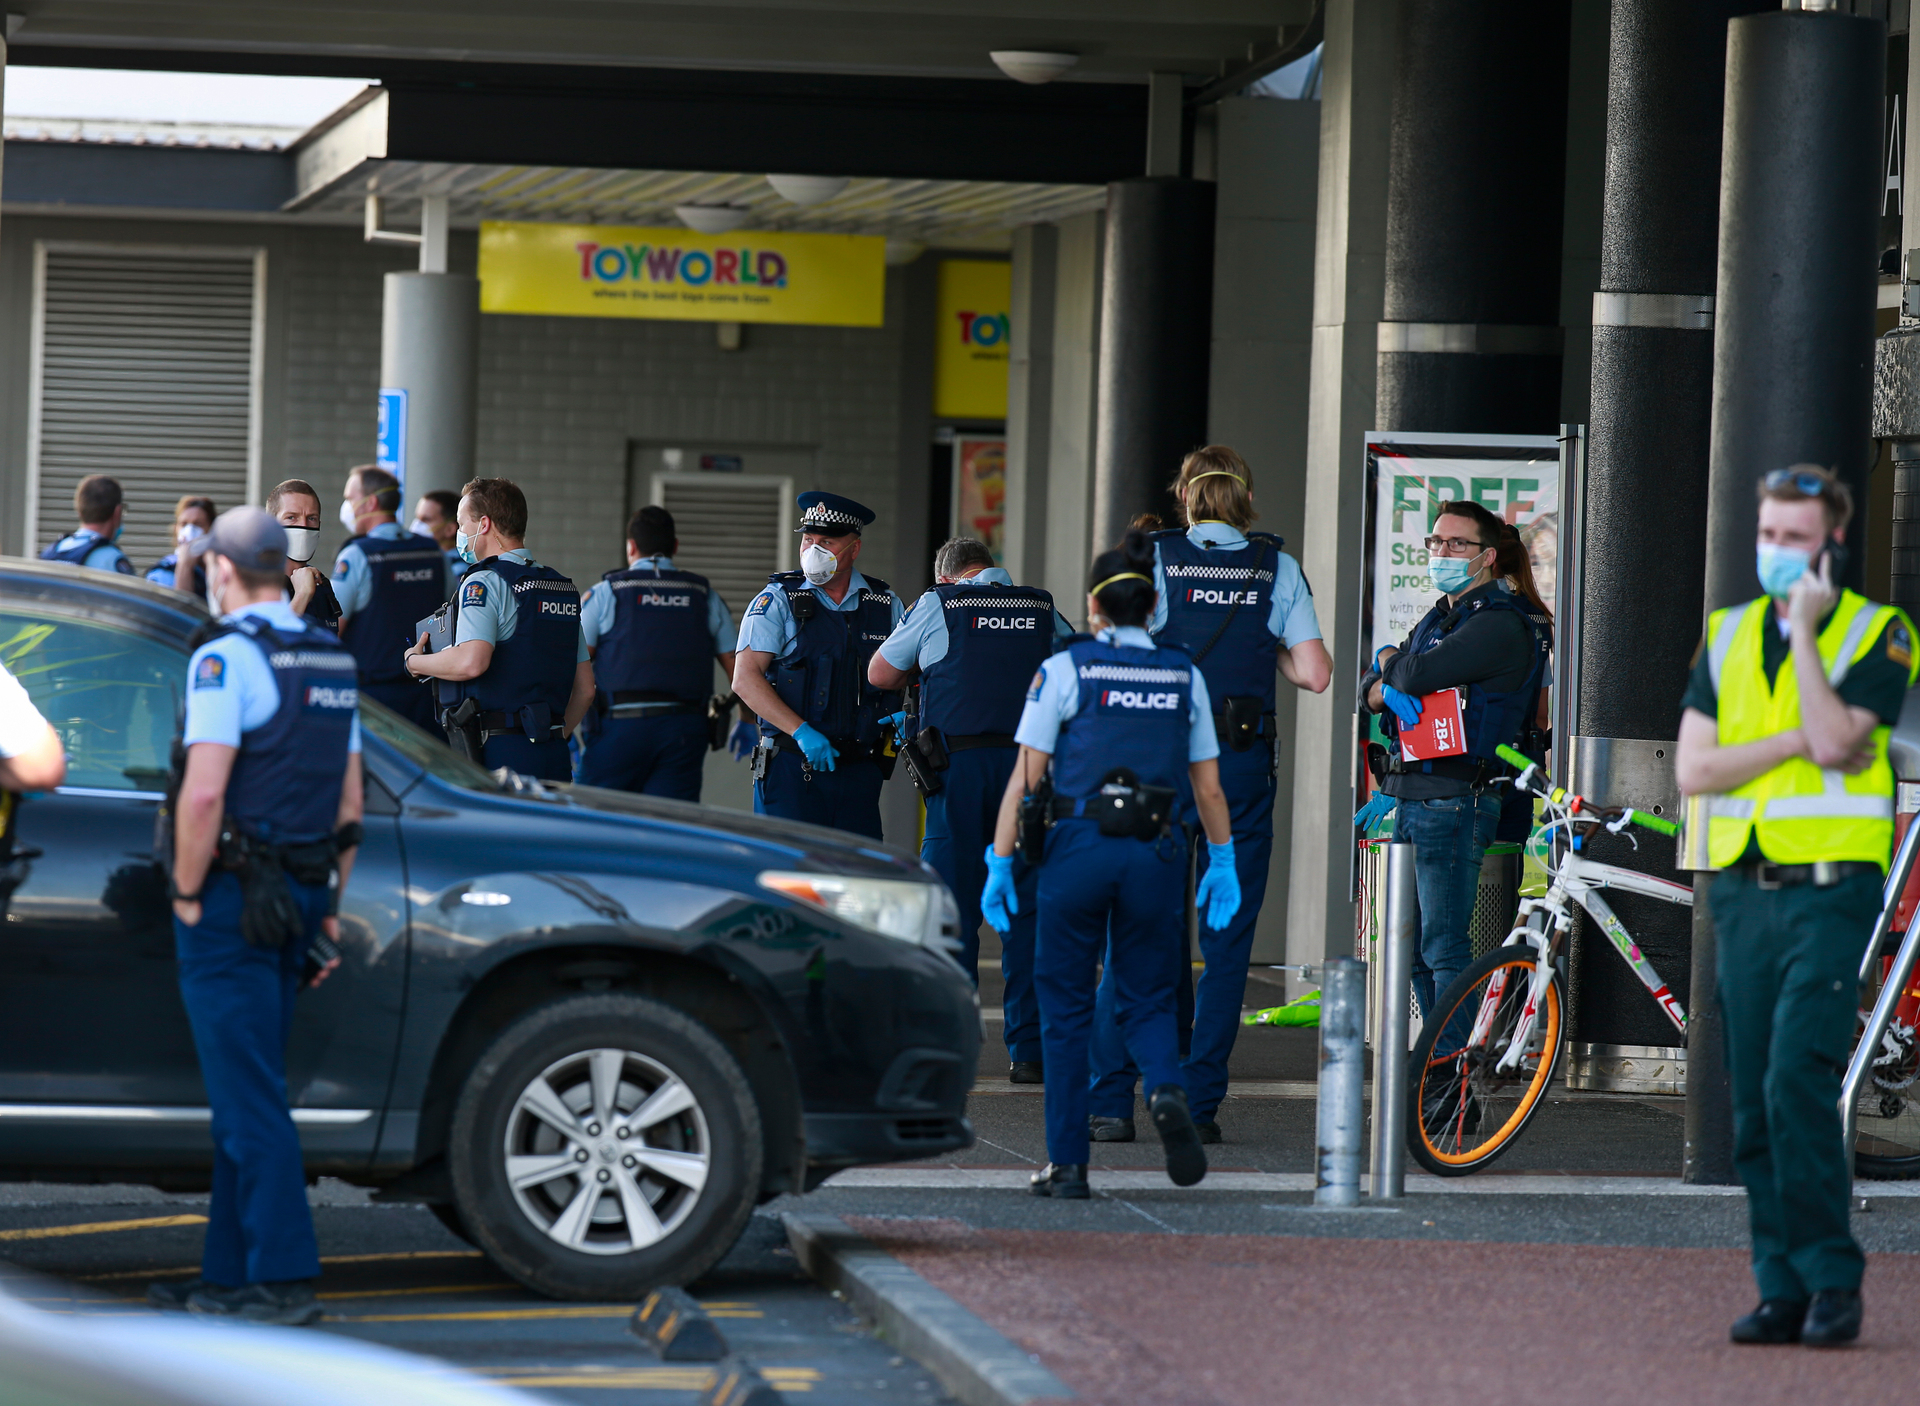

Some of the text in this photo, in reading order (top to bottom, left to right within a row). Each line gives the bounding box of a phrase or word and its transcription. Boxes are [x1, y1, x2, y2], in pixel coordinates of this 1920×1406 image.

[1391, 542, 1429, 566] Sta
[395, 569, 433, 581] POLICE
[1390, 574, 1432, 592] prog
[642, 594, 690, 606] POLICE
[1192, 589, 1258, 605] POLICE
[542, 601, 577, 616] POLICE
[1390, 602, 1413, 613] with
[977, 617, 1036, 630] POLICE
[1390, 620, 1407, 630] the
[1107, 690, 1180, 709] POLICE
[1434, 717, 1451, 751] 2B4
